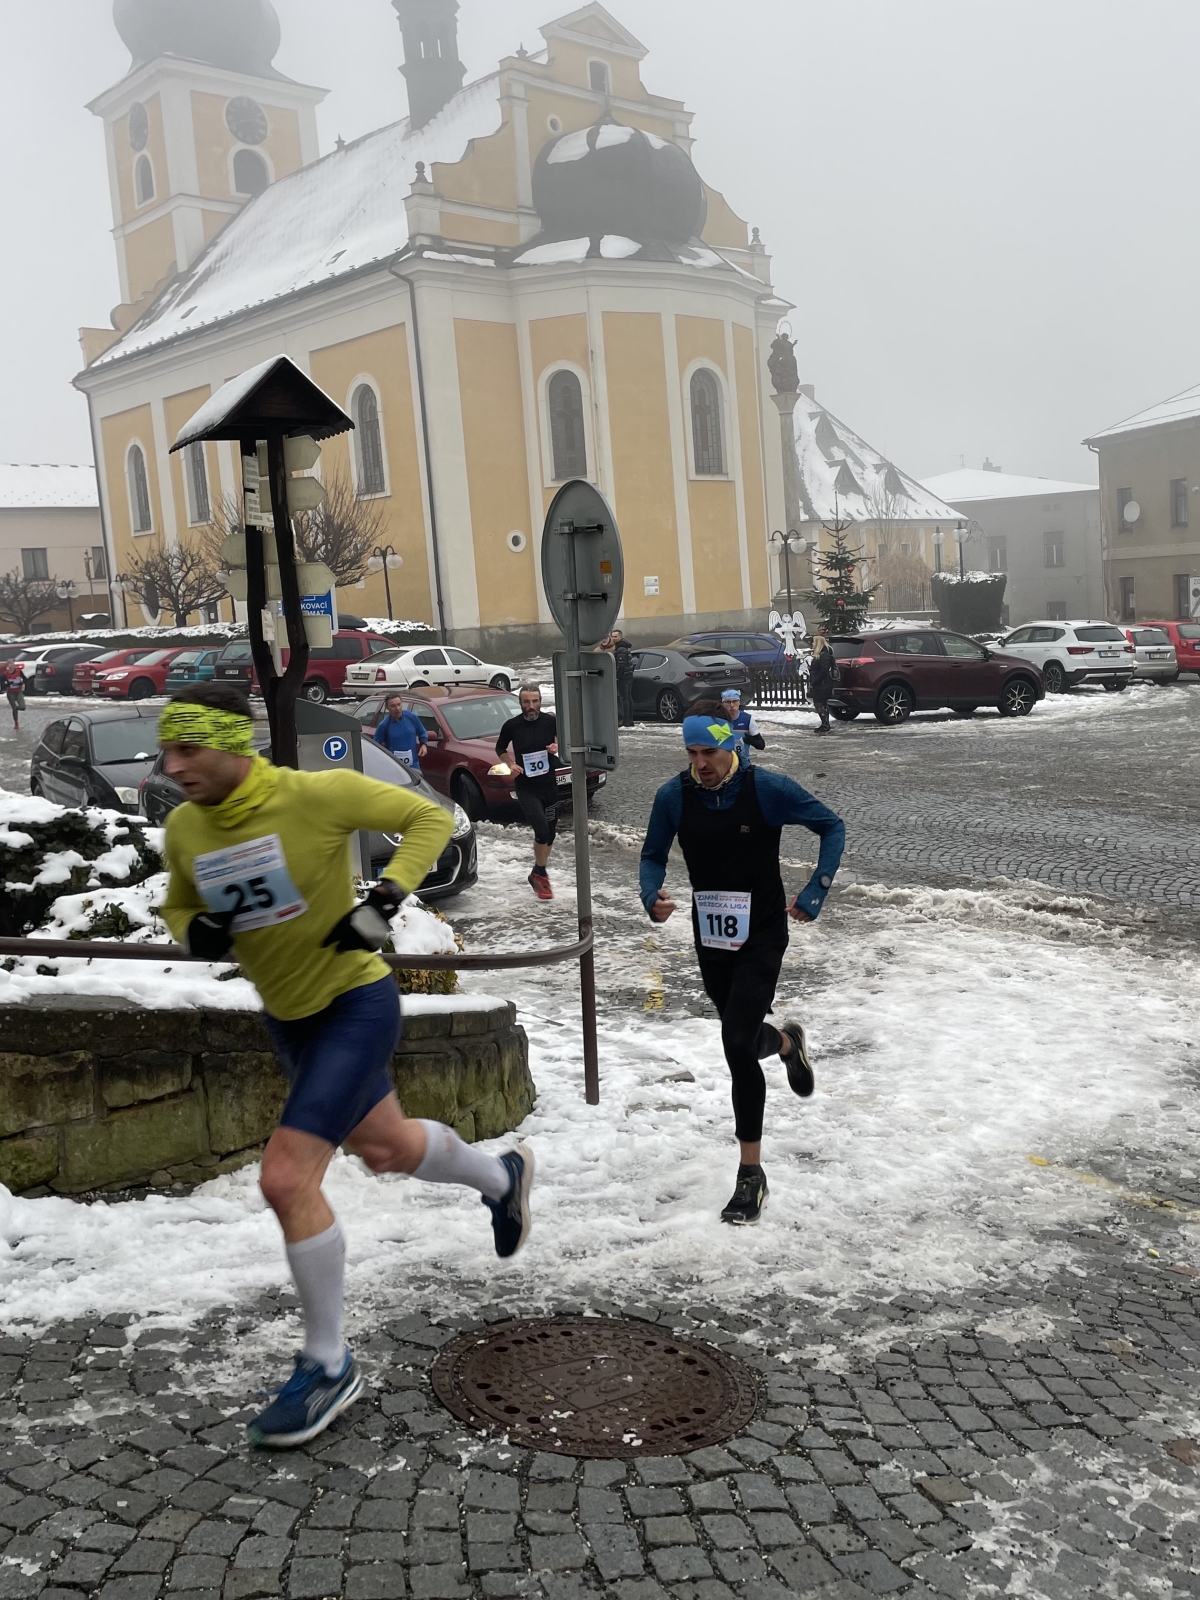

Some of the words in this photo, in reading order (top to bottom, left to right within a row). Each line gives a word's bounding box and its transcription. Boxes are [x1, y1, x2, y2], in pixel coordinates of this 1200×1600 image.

[301, 600, 327, 610] KOVACÍ
[330, 741, 342, 757] P
[529, 760, 544, 772] 30
[222, 876, 277, 914] 25
[696, 893, 718, 901] ZIMNÍ
[706, 913, 738, 938] 118
